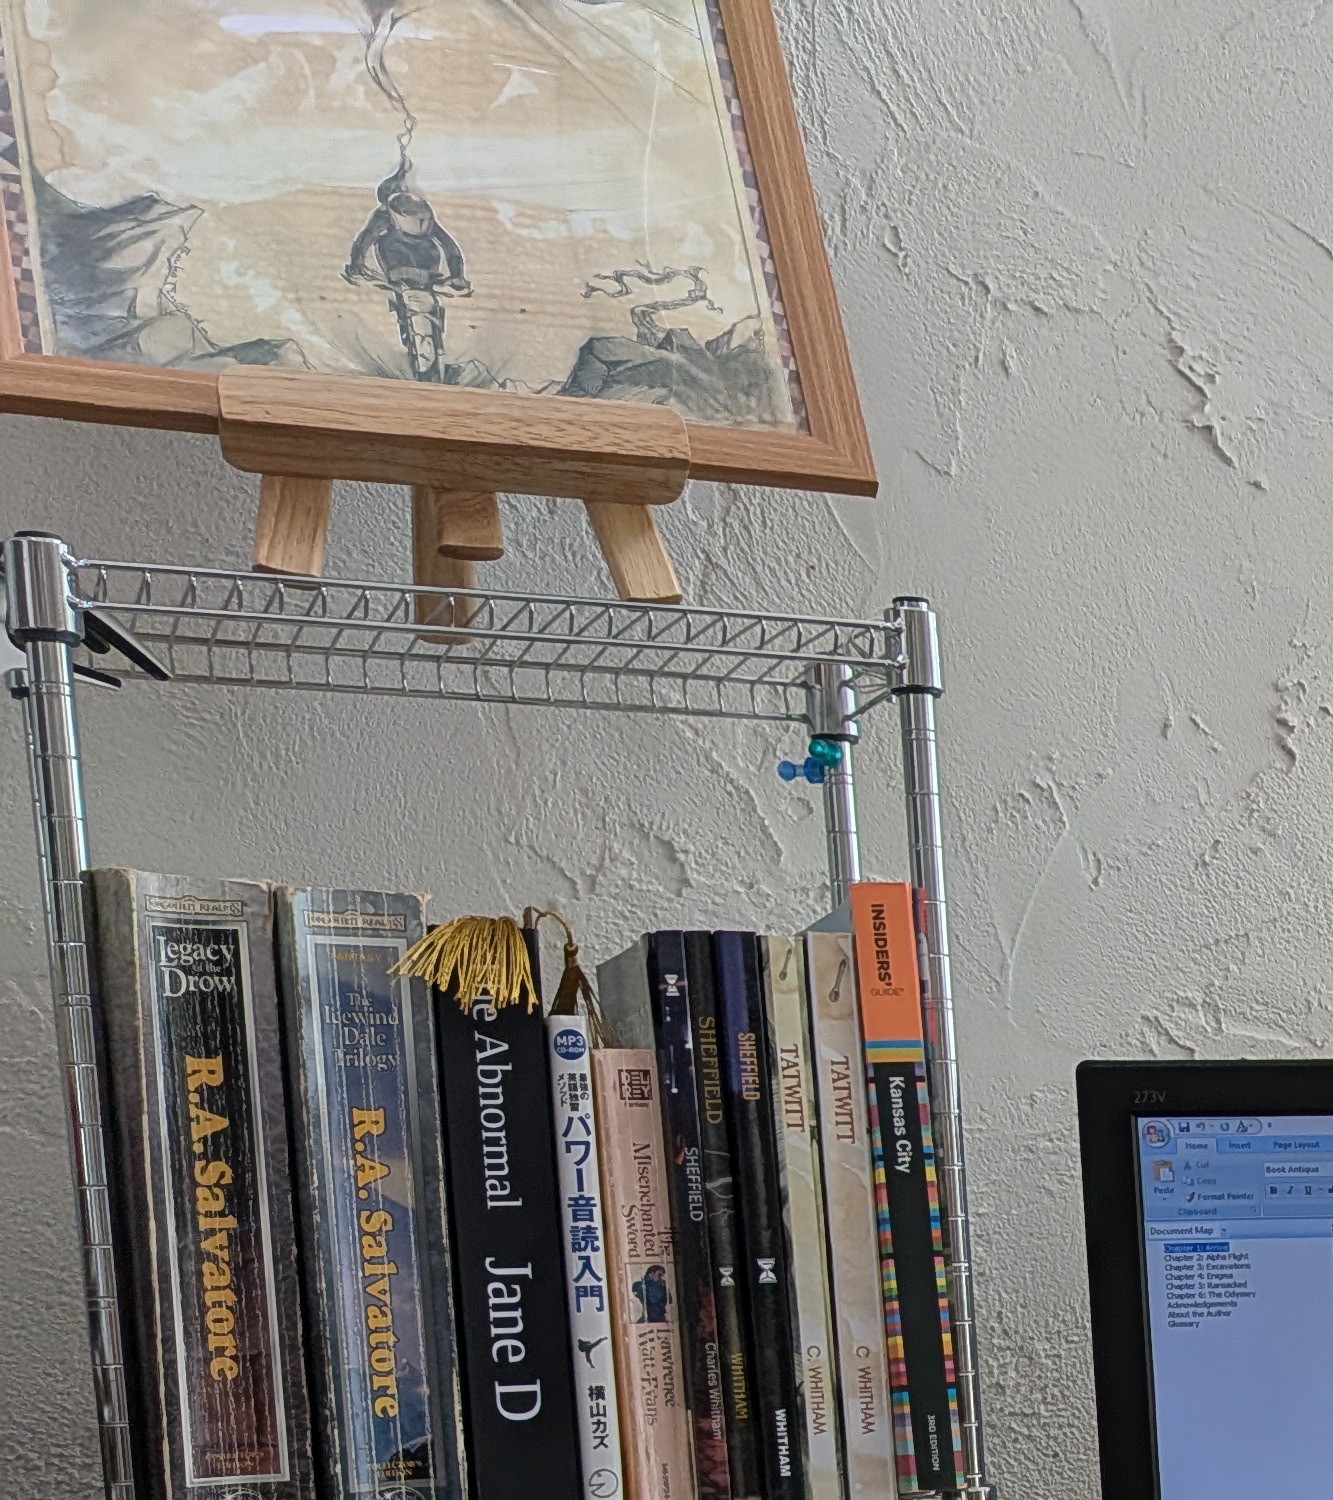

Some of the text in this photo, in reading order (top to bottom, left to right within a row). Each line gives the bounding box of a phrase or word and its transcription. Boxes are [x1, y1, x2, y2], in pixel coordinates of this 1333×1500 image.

[157, 936, 235, 967] Legacy
[163, 967, 236, 998] Drow
[867, 902, 894, 987] INSIDERS'
[324, 1004, 399, 1027] Icewind
[344, 1026, 386, 1046] Dale
[346, 992, 372, 1006] The
[334, 1048, 400, 1071] Trilogy
[556, 1035, 584, 1046] MP3
[698, 1016, 724, 1125] SHEFFIELD
[738, 1032, 761, 1101] SHEFFIELD
[473, 1030, 524, 1211] Abnormal
[780, 1044, 806, 1134] TATWITT
[830, 1056, 856, 1144] TATWITT
[888, 1076, 912, 1174] Kansas City
[562, 1114, 605, 1313] パワー音読入門
[632, 1142, 657, 1258] Misenchanted
[685, 1147, 704, 1222] SHEFFIELD
[193, 1157, 237, 1381] Salvatore
[621, 1204, 642, 1259] Sword
[357, 1210, 402, 1420] Salvatore
[486, 1256, 541, 1421] Jane D
[637, 1327, 659, 1427] Watt-Evans
[656, 1327, 678, 1408] Lawrence
[704, 1342, 723, 1441] Charles Whitham
[731, 1353, 748, 1420] WHITHAM
[806, 1345, 828, 1436] C. WHITHAM
[858, 1366, 875, 1436] WHITHAM
[587, 1385, 609, 1449] 横山カズ
[774, 1408, 791, 1477] WHITHAM
[928, 1414, 941, 1471] 3RD EDITION
